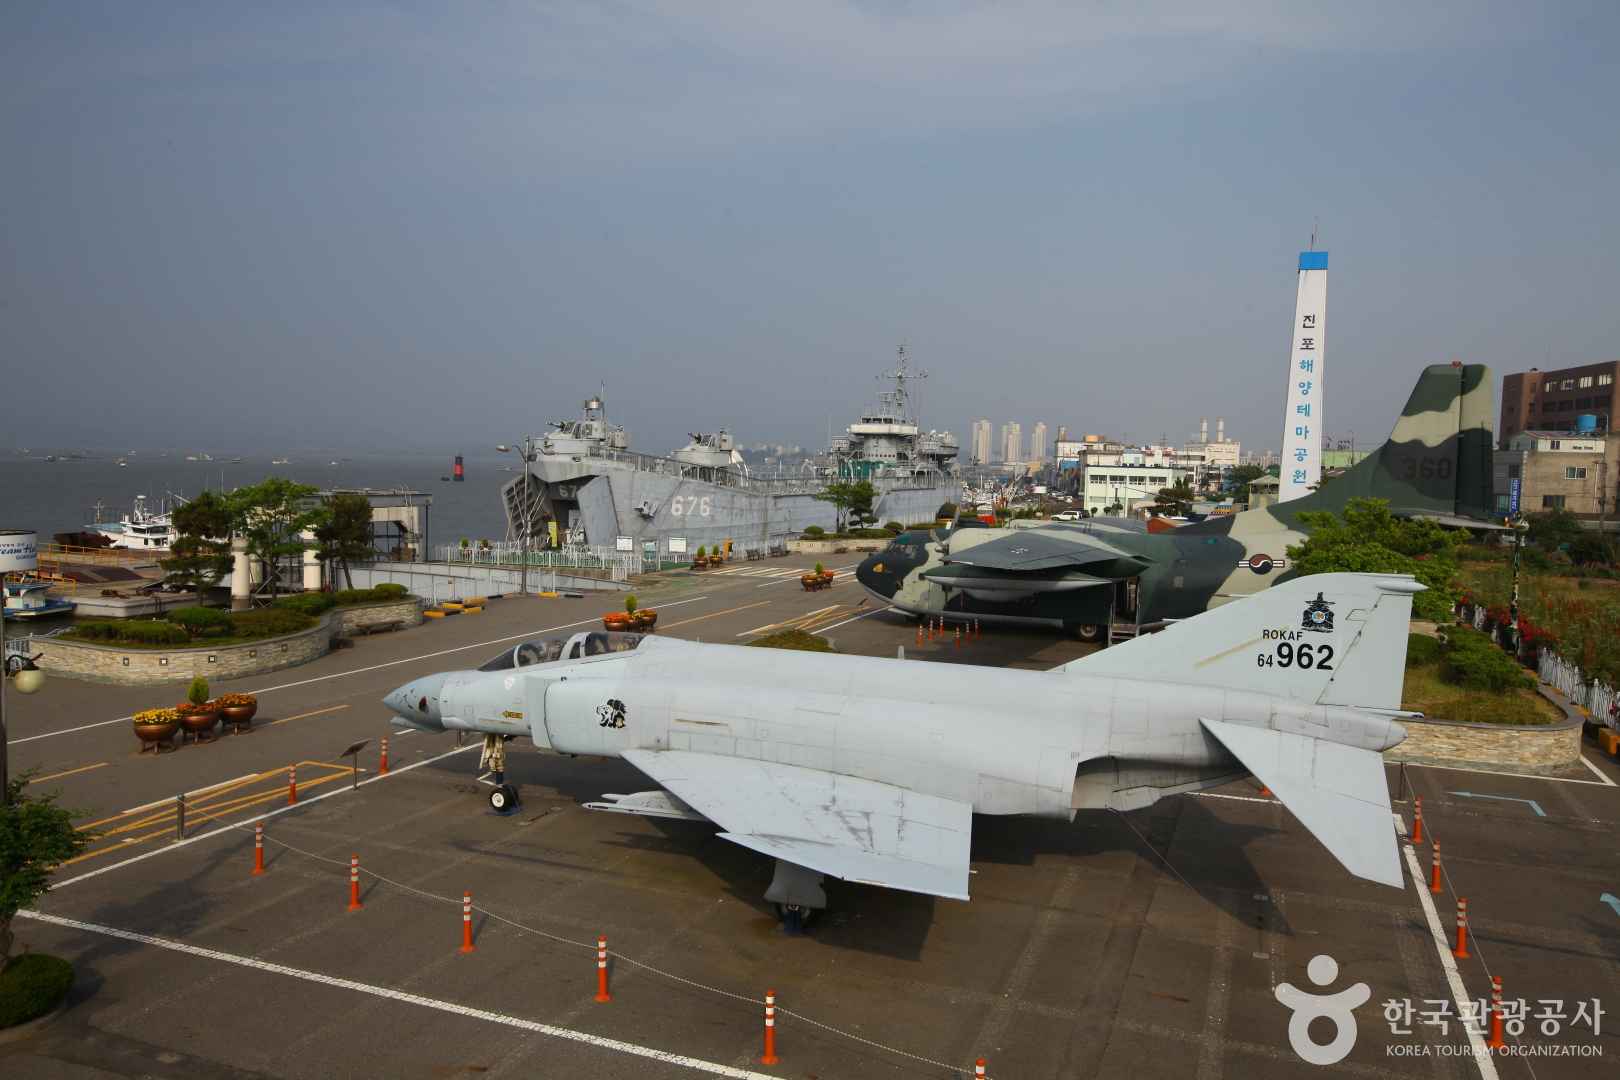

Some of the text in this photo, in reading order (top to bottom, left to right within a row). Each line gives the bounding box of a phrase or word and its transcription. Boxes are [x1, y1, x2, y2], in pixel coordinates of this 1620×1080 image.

[1401, 456, 1451, 480] 360
[671, 495, 711, 517] 676
[1263, 629, 1304, 641] ROKAF
[1257, 641, 1334, 671] 64 962
